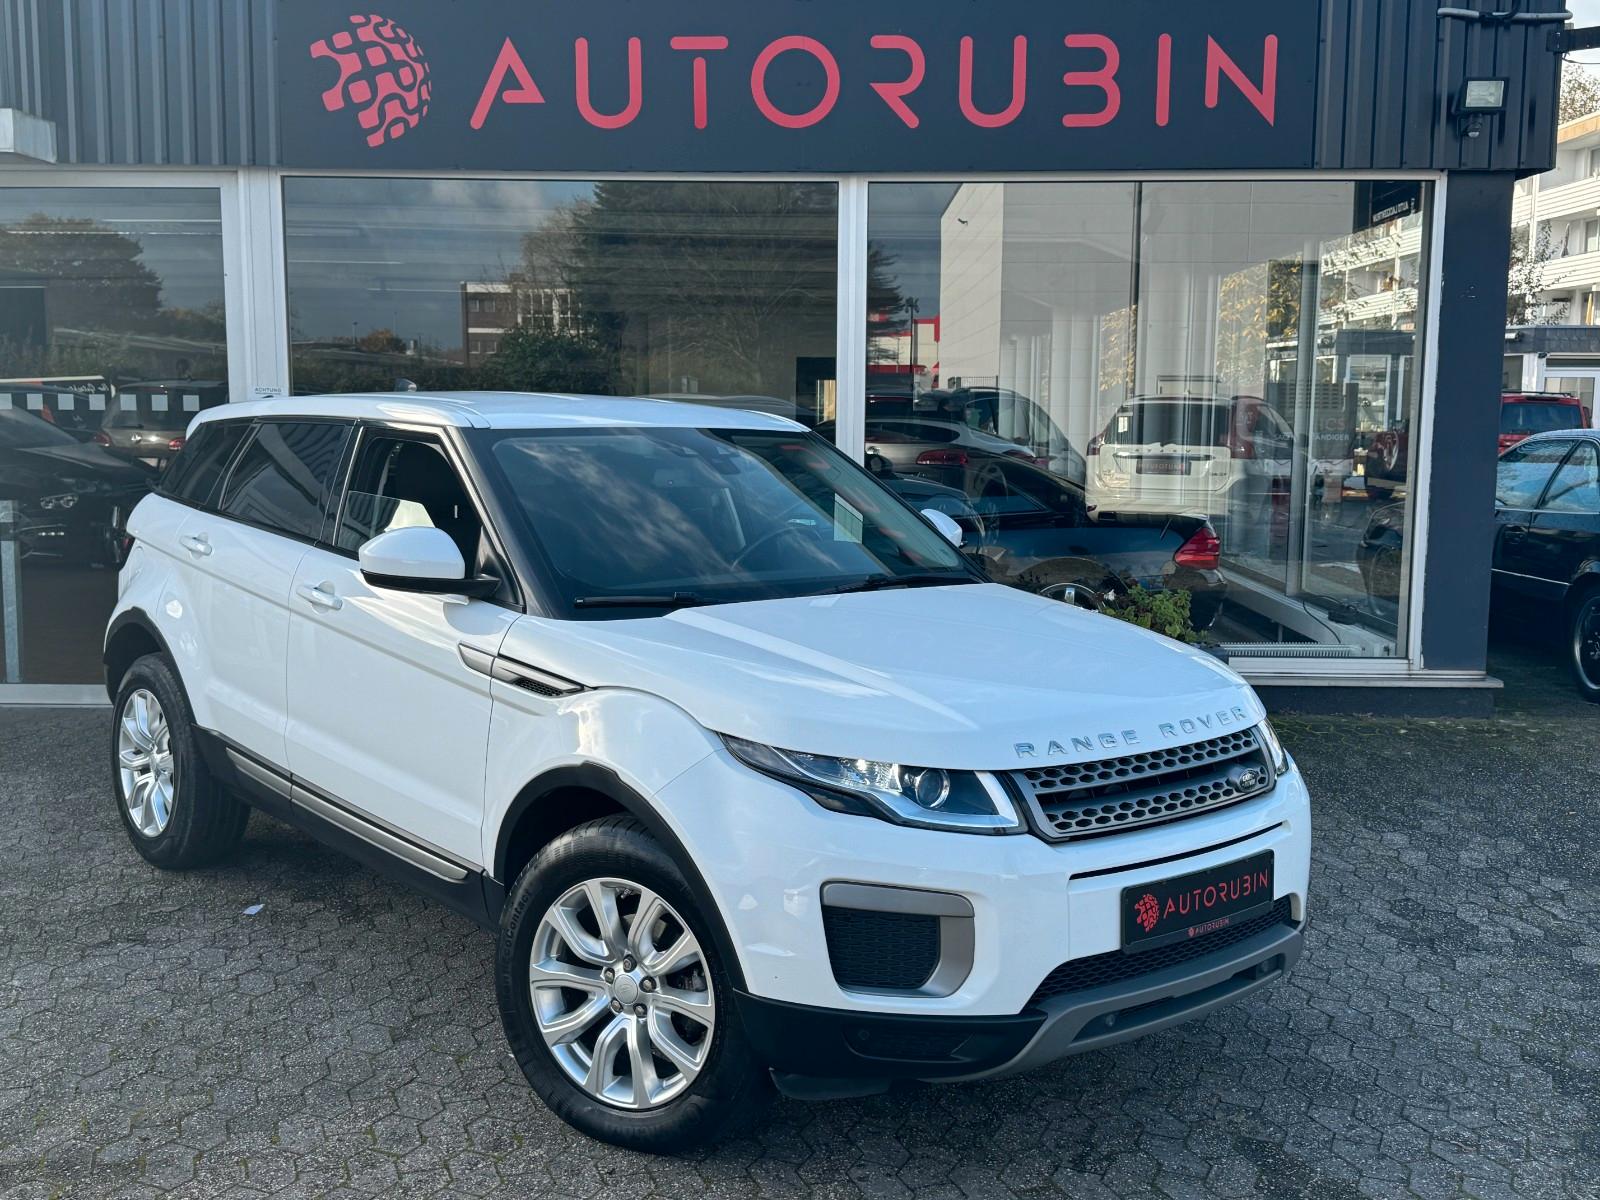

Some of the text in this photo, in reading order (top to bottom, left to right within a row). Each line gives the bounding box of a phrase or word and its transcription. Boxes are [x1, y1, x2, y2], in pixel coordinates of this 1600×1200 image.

[469, 34, 1278, 129] AUTORUBIN
[1013, 707, 1247, 758] RANGE ROVER
[1163, 868, 1269, 919] AUTORUBIN
[1194, 917, 1230, 935] AUTORUBIN
